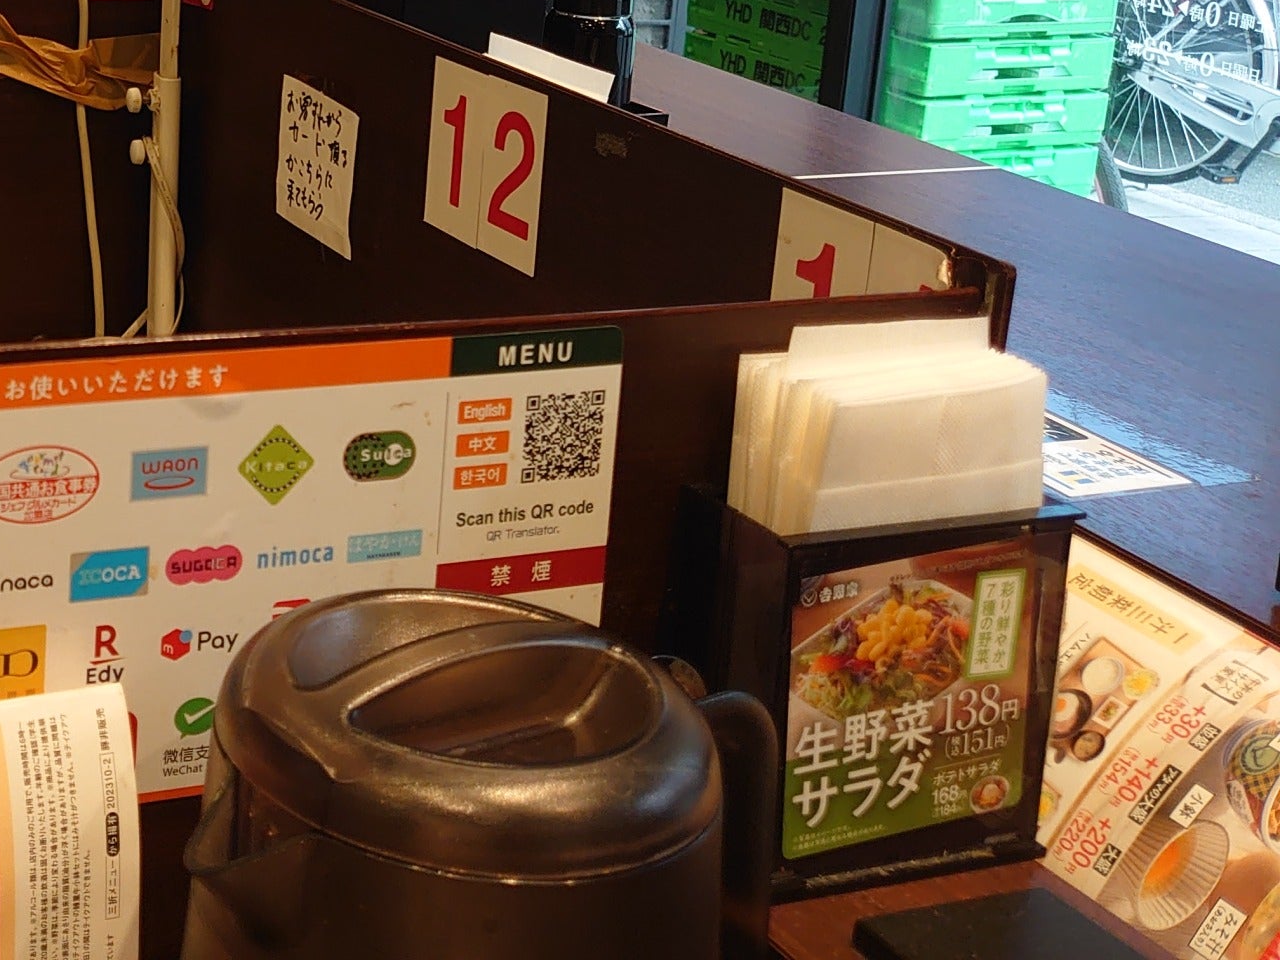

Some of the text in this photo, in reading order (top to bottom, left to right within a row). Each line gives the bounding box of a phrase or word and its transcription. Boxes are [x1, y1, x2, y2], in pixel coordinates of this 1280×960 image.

[443, 94, 536, 242] 12
[498, 342, 574, 368] MENU
[4, 365, 230, 401] お使いいただけます
[463, 403, 506, 423] English
[359, 445, 412, 463] Suica
[467, 435, 498, 454] 中文
[140, 457, 200, 477] WAON
[244, 457, 308, 473] Kitaca
[460, 467, 501, 487] 한국어
[455, 499, 594, 529] Scan this QR code
[485, 526, 560, 543] QR Translator.
[169, 554, 238, 575] SUGOCA
[256, 544, 335, 569] nimoca
[78, 564, 142, 586] ICOCA
[197, 630, 239, 653] Pay
[85, 665, 125, 685] Edy
[934, 683, 1020, 736] 138円
[793, 698, 936, 776] 生野菜
[162, 763, 204, 777] WeChat
[932, 758, 1002, 786] ポテトサラダ
[792, 749, 933, 829] サラダ
